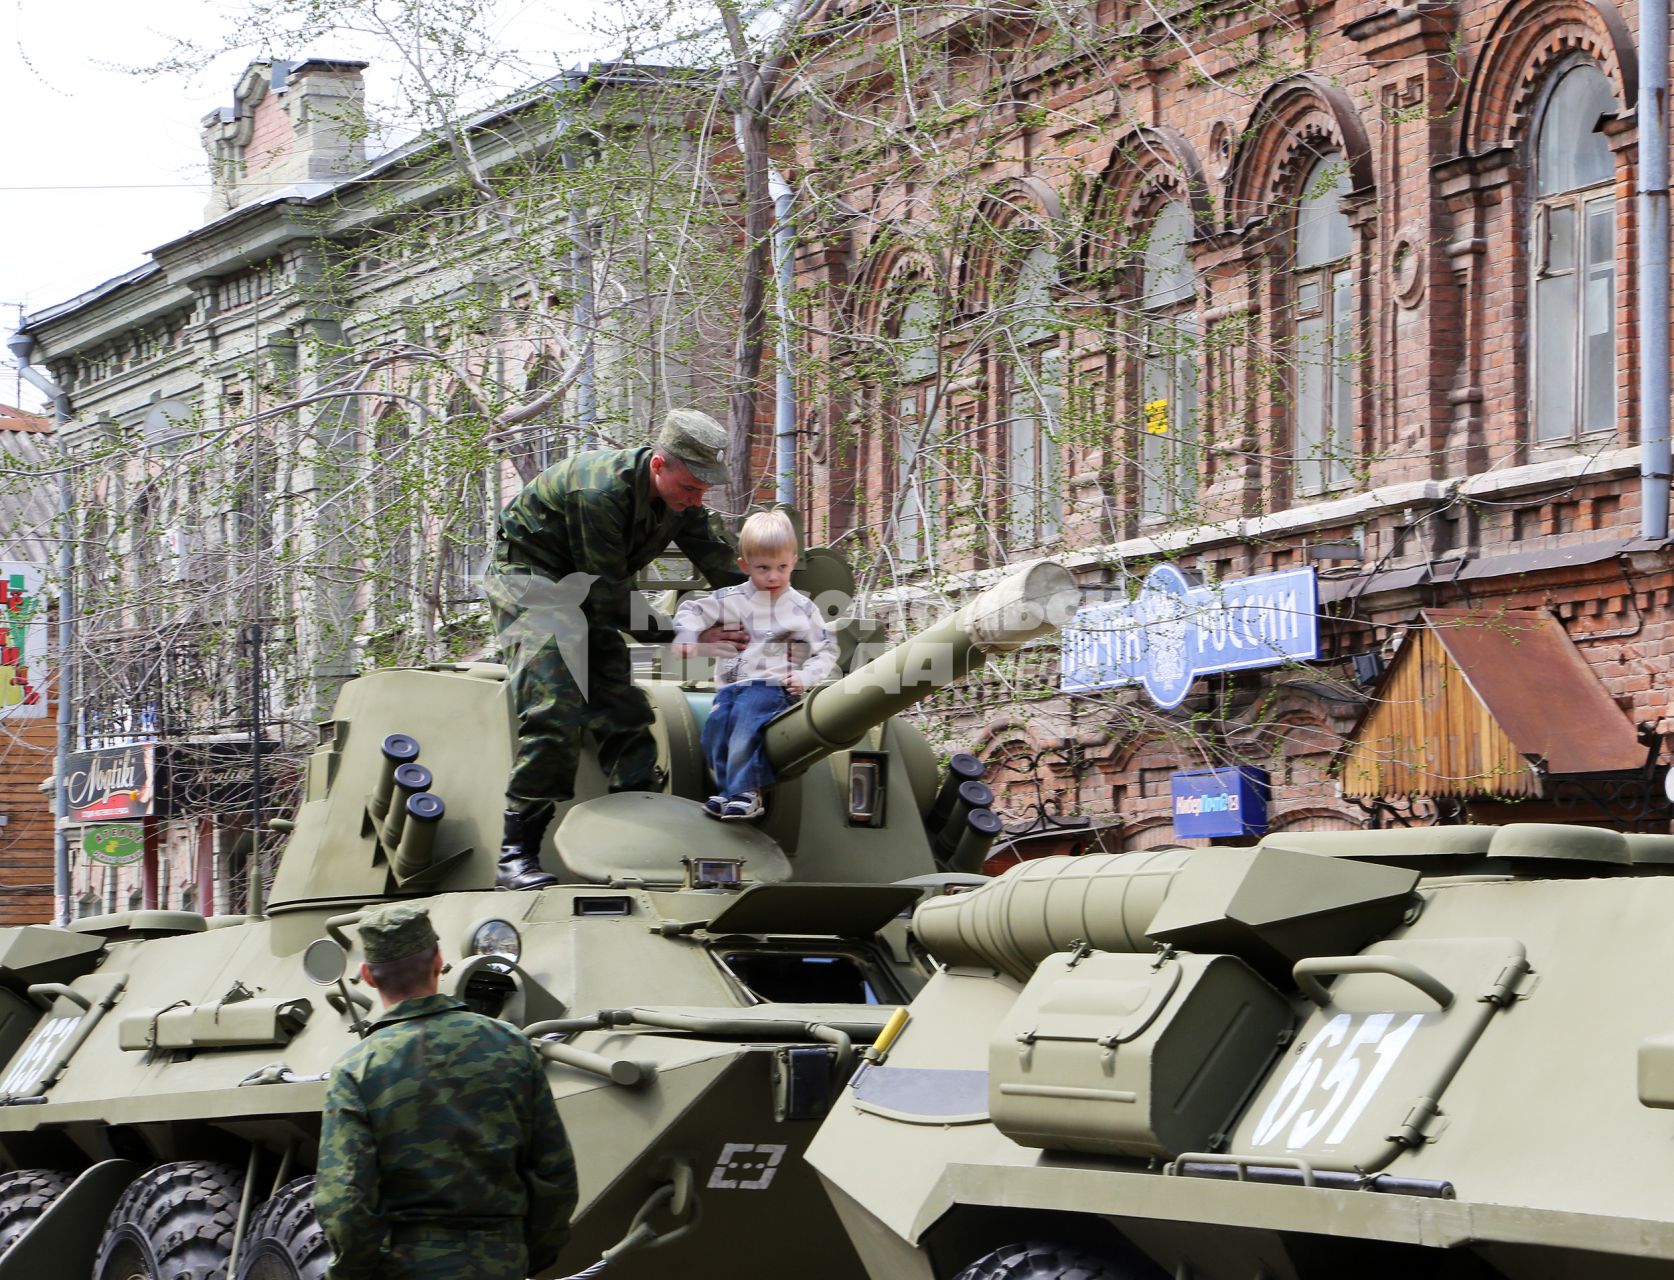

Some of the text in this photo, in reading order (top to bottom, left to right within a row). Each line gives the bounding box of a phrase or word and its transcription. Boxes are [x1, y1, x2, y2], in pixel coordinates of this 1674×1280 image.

[1068, 589, 1299, 672] ПОЧТА РОССИИ
[69, 750, 136, 803] Nogtiki
[0, 1017, 82, 1093] 653
[1251, 1014, 1425, 1149] 651
